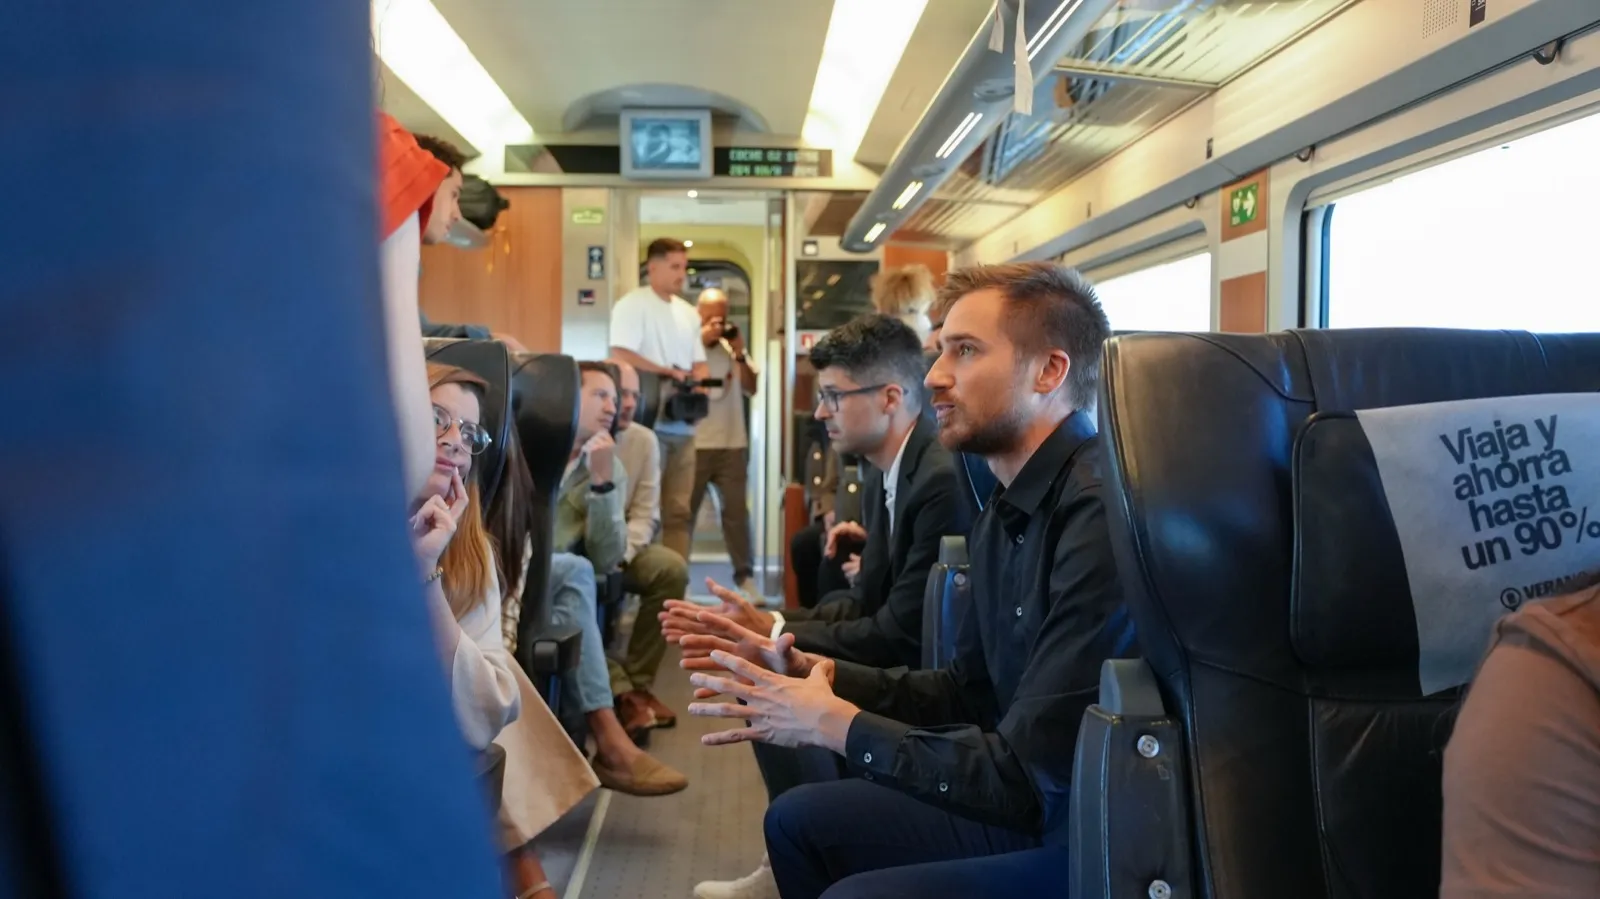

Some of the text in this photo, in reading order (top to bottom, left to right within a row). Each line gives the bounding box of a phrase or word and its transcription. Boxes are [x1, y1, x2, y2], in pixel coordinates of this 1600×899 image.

[1439, 414, 1557, 465] Viaja y
[1453, 449, 1573, 501] ahorra
[1468, 484, 1572, 533] hasta
[1461, 506, 1600, 571] un 90%
